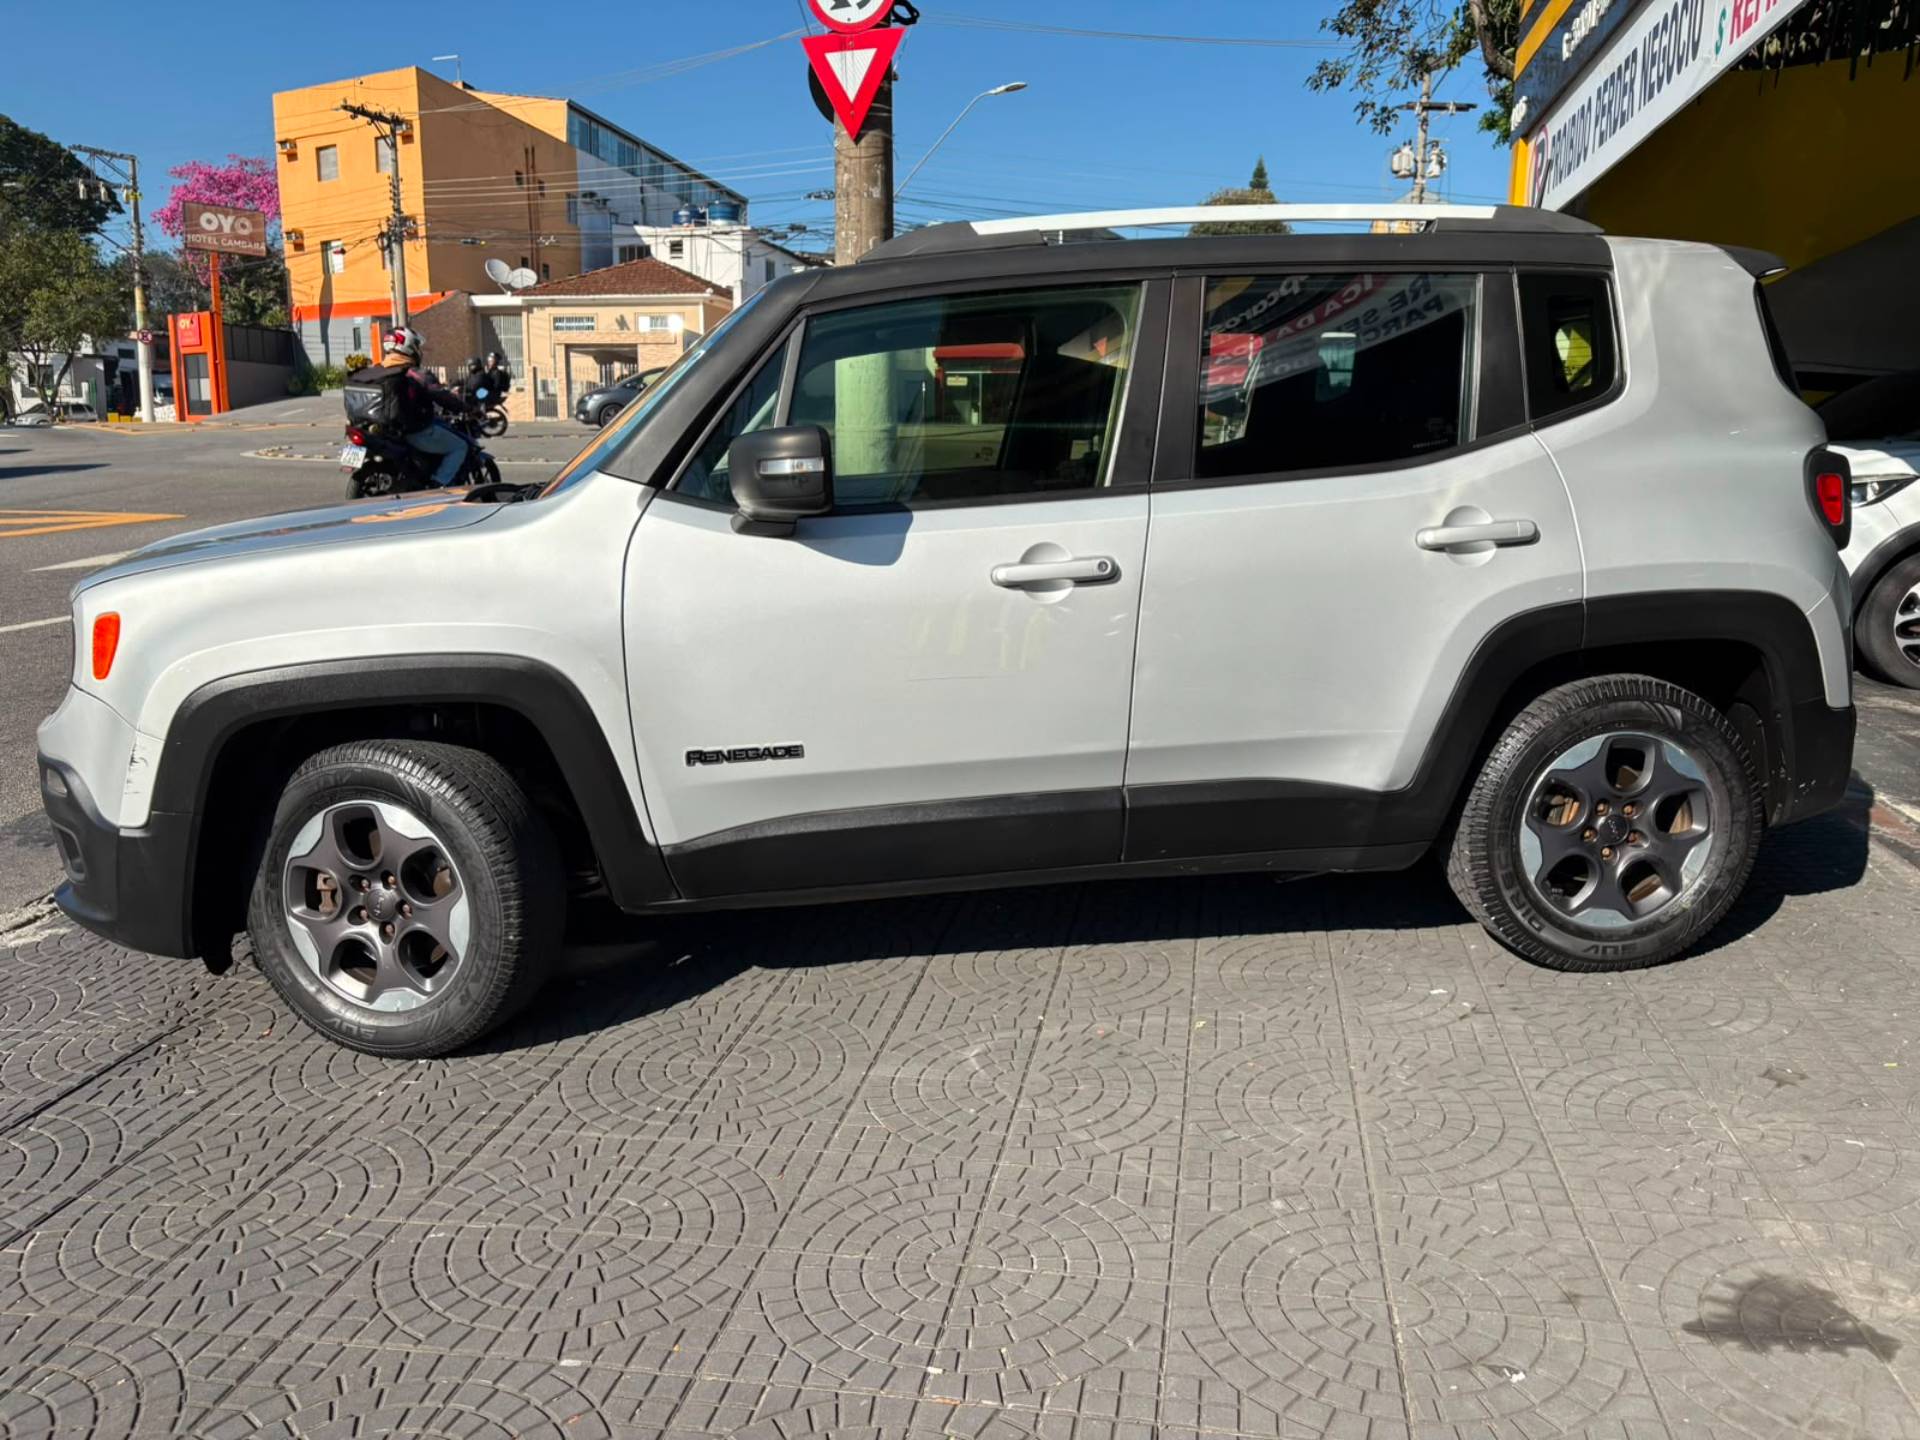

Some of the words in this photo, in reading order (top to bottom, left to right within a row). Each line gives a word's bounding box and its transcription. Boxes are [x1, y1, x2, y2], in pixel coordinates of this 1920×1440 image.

[1546, 95, 1593, 195] PROIBIDO
[1591, 47, 1638, 155] PERDER
[1638, 0, 1704, 112] NEGOCIO
[200, 212, 253, 236] OYO
[187, 233, 219, 246] HOTEL
[685, 744, 805, 767] RENEGADE
